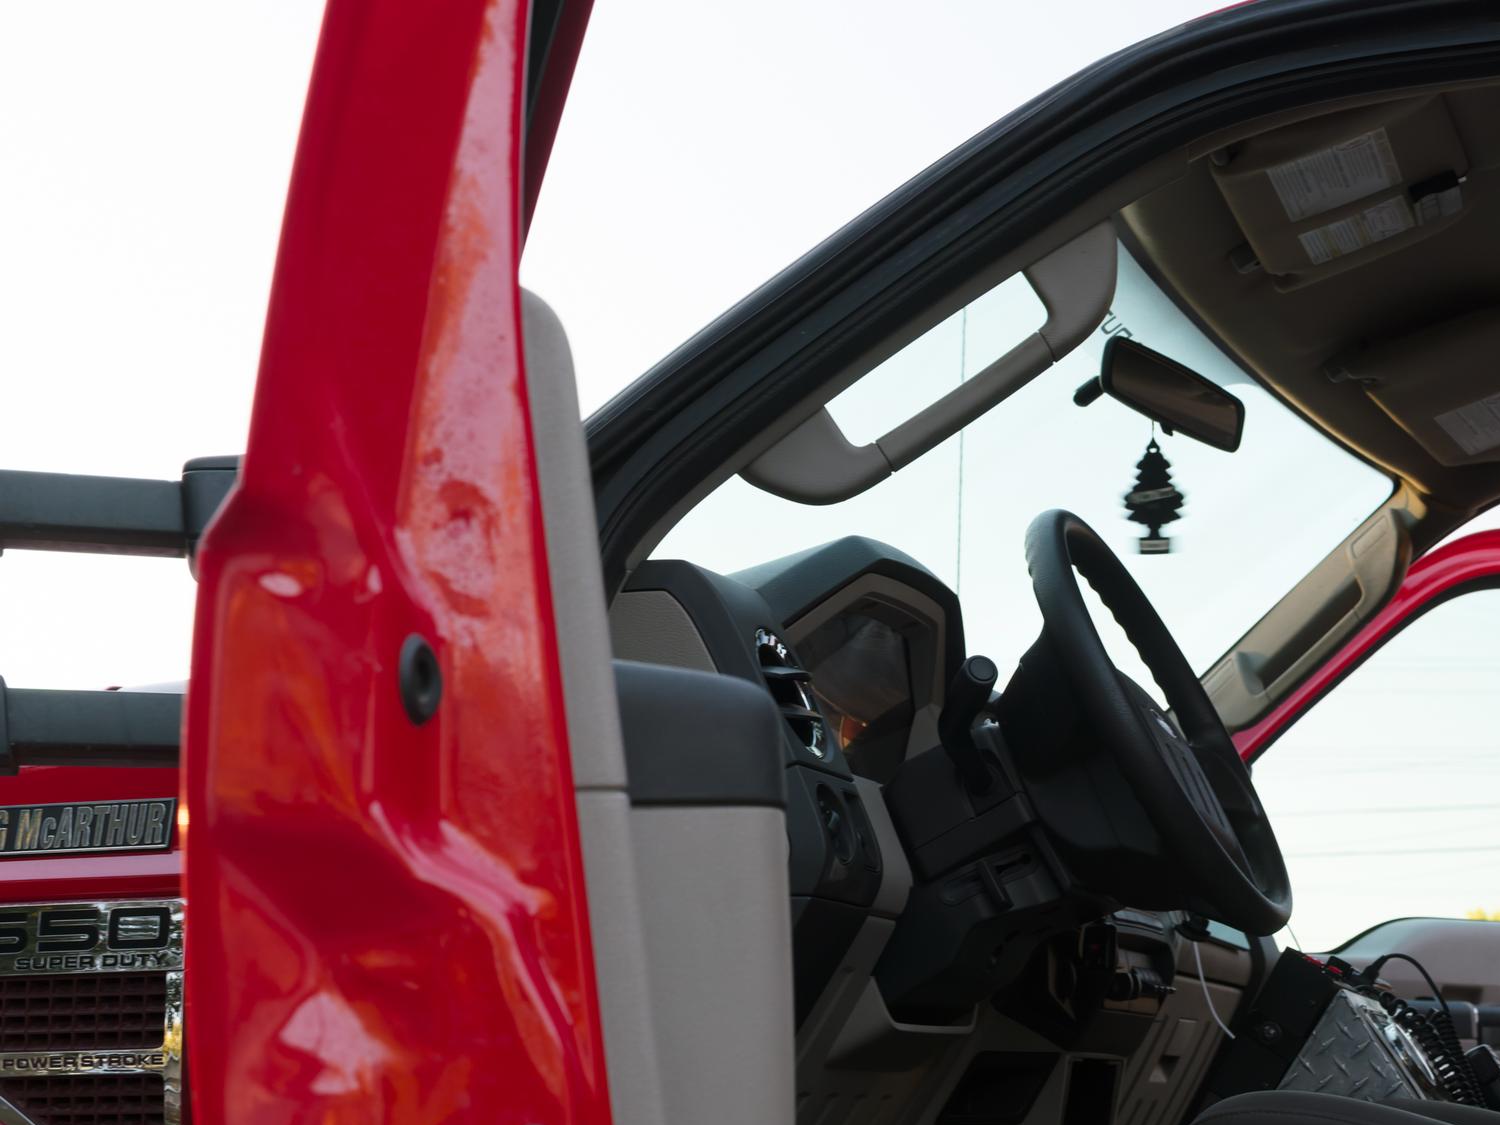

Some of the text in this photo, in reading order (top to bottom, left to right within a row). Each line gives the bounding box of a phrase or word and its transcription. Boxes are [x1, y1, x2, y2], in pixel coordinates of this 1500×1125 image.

[15, 802, 167, 851] McARTHUR
[15, 952, 163, 971] SUPER DUTY
